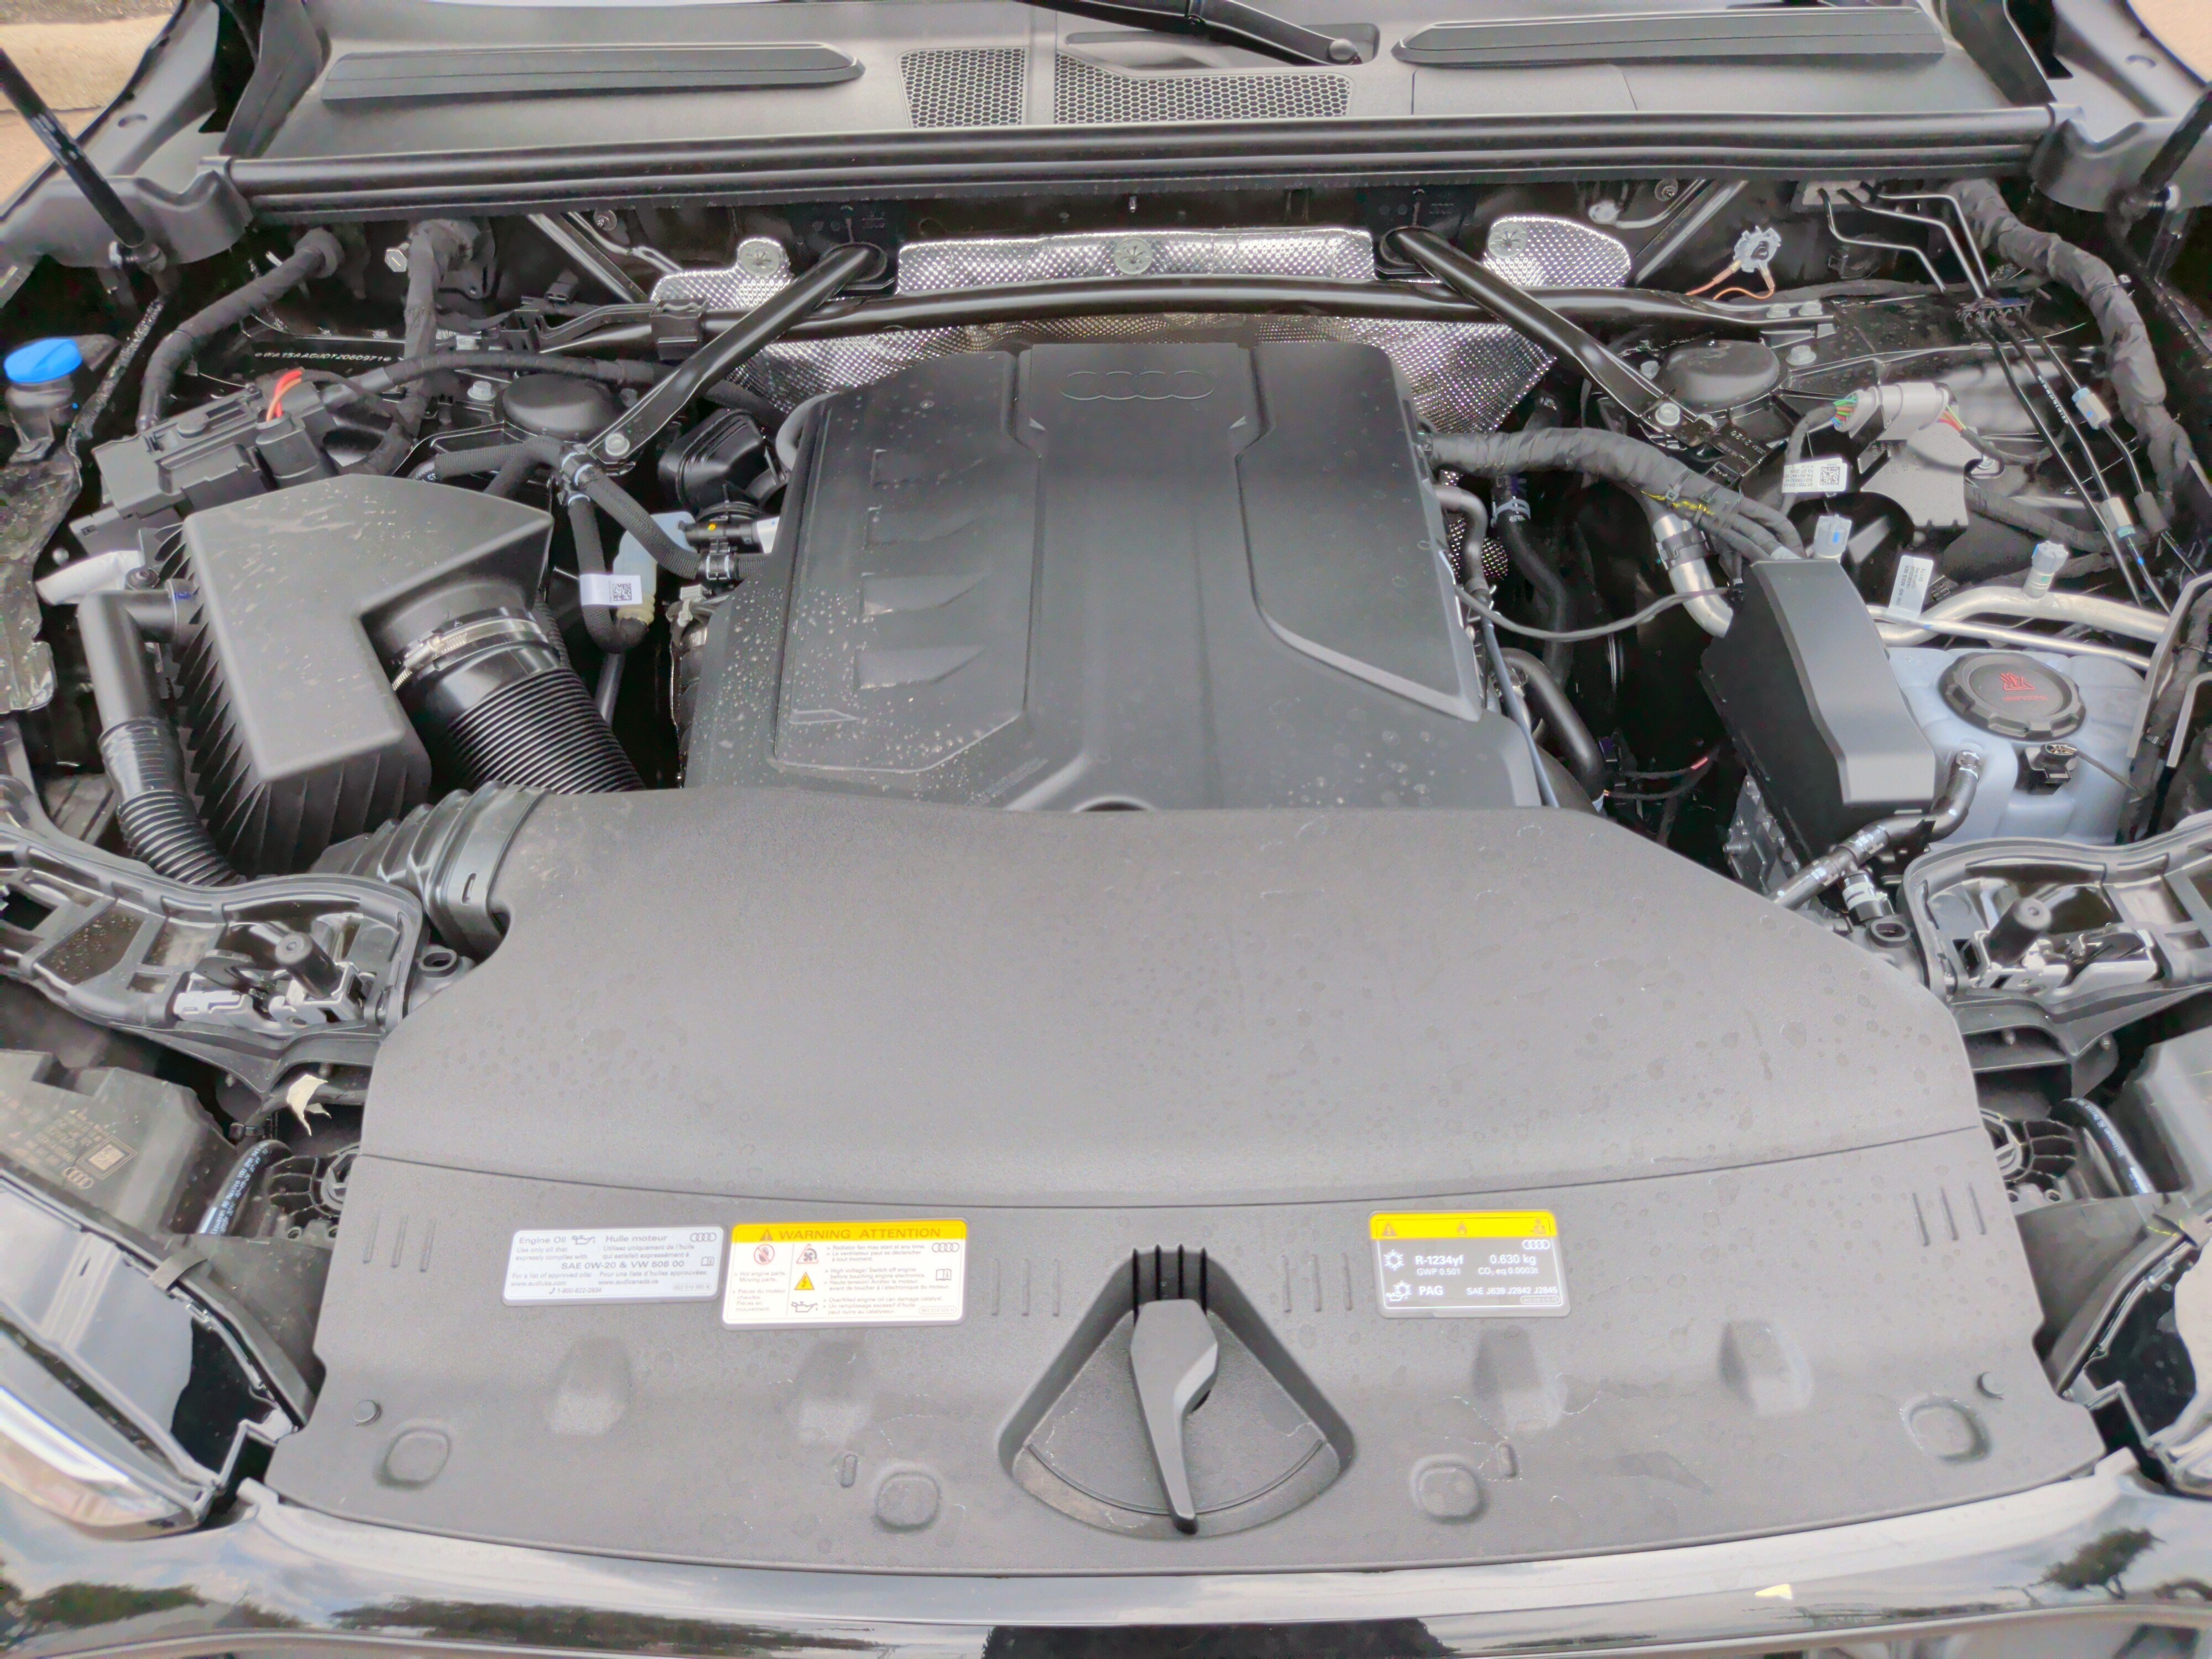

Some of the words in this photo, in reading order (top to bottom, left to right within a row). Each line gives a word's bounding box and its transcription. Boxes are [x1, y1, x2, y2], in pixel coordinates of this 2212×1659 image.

[779, 1229, 851, 1240] WARNING
[859, 1228, 941, 1238] ATTENTION
[519, 1237, 550, 1245] Engine
[1415, 1254, 1464, 1267] R-1234yf
[1489, 1254, 1520, 1264] 0.630
[1523, 1254, 1536, 1265] kg
[1417, 1267, 1437, 1276] GWP
[1418, 1285, 1444, 1296] PAG
